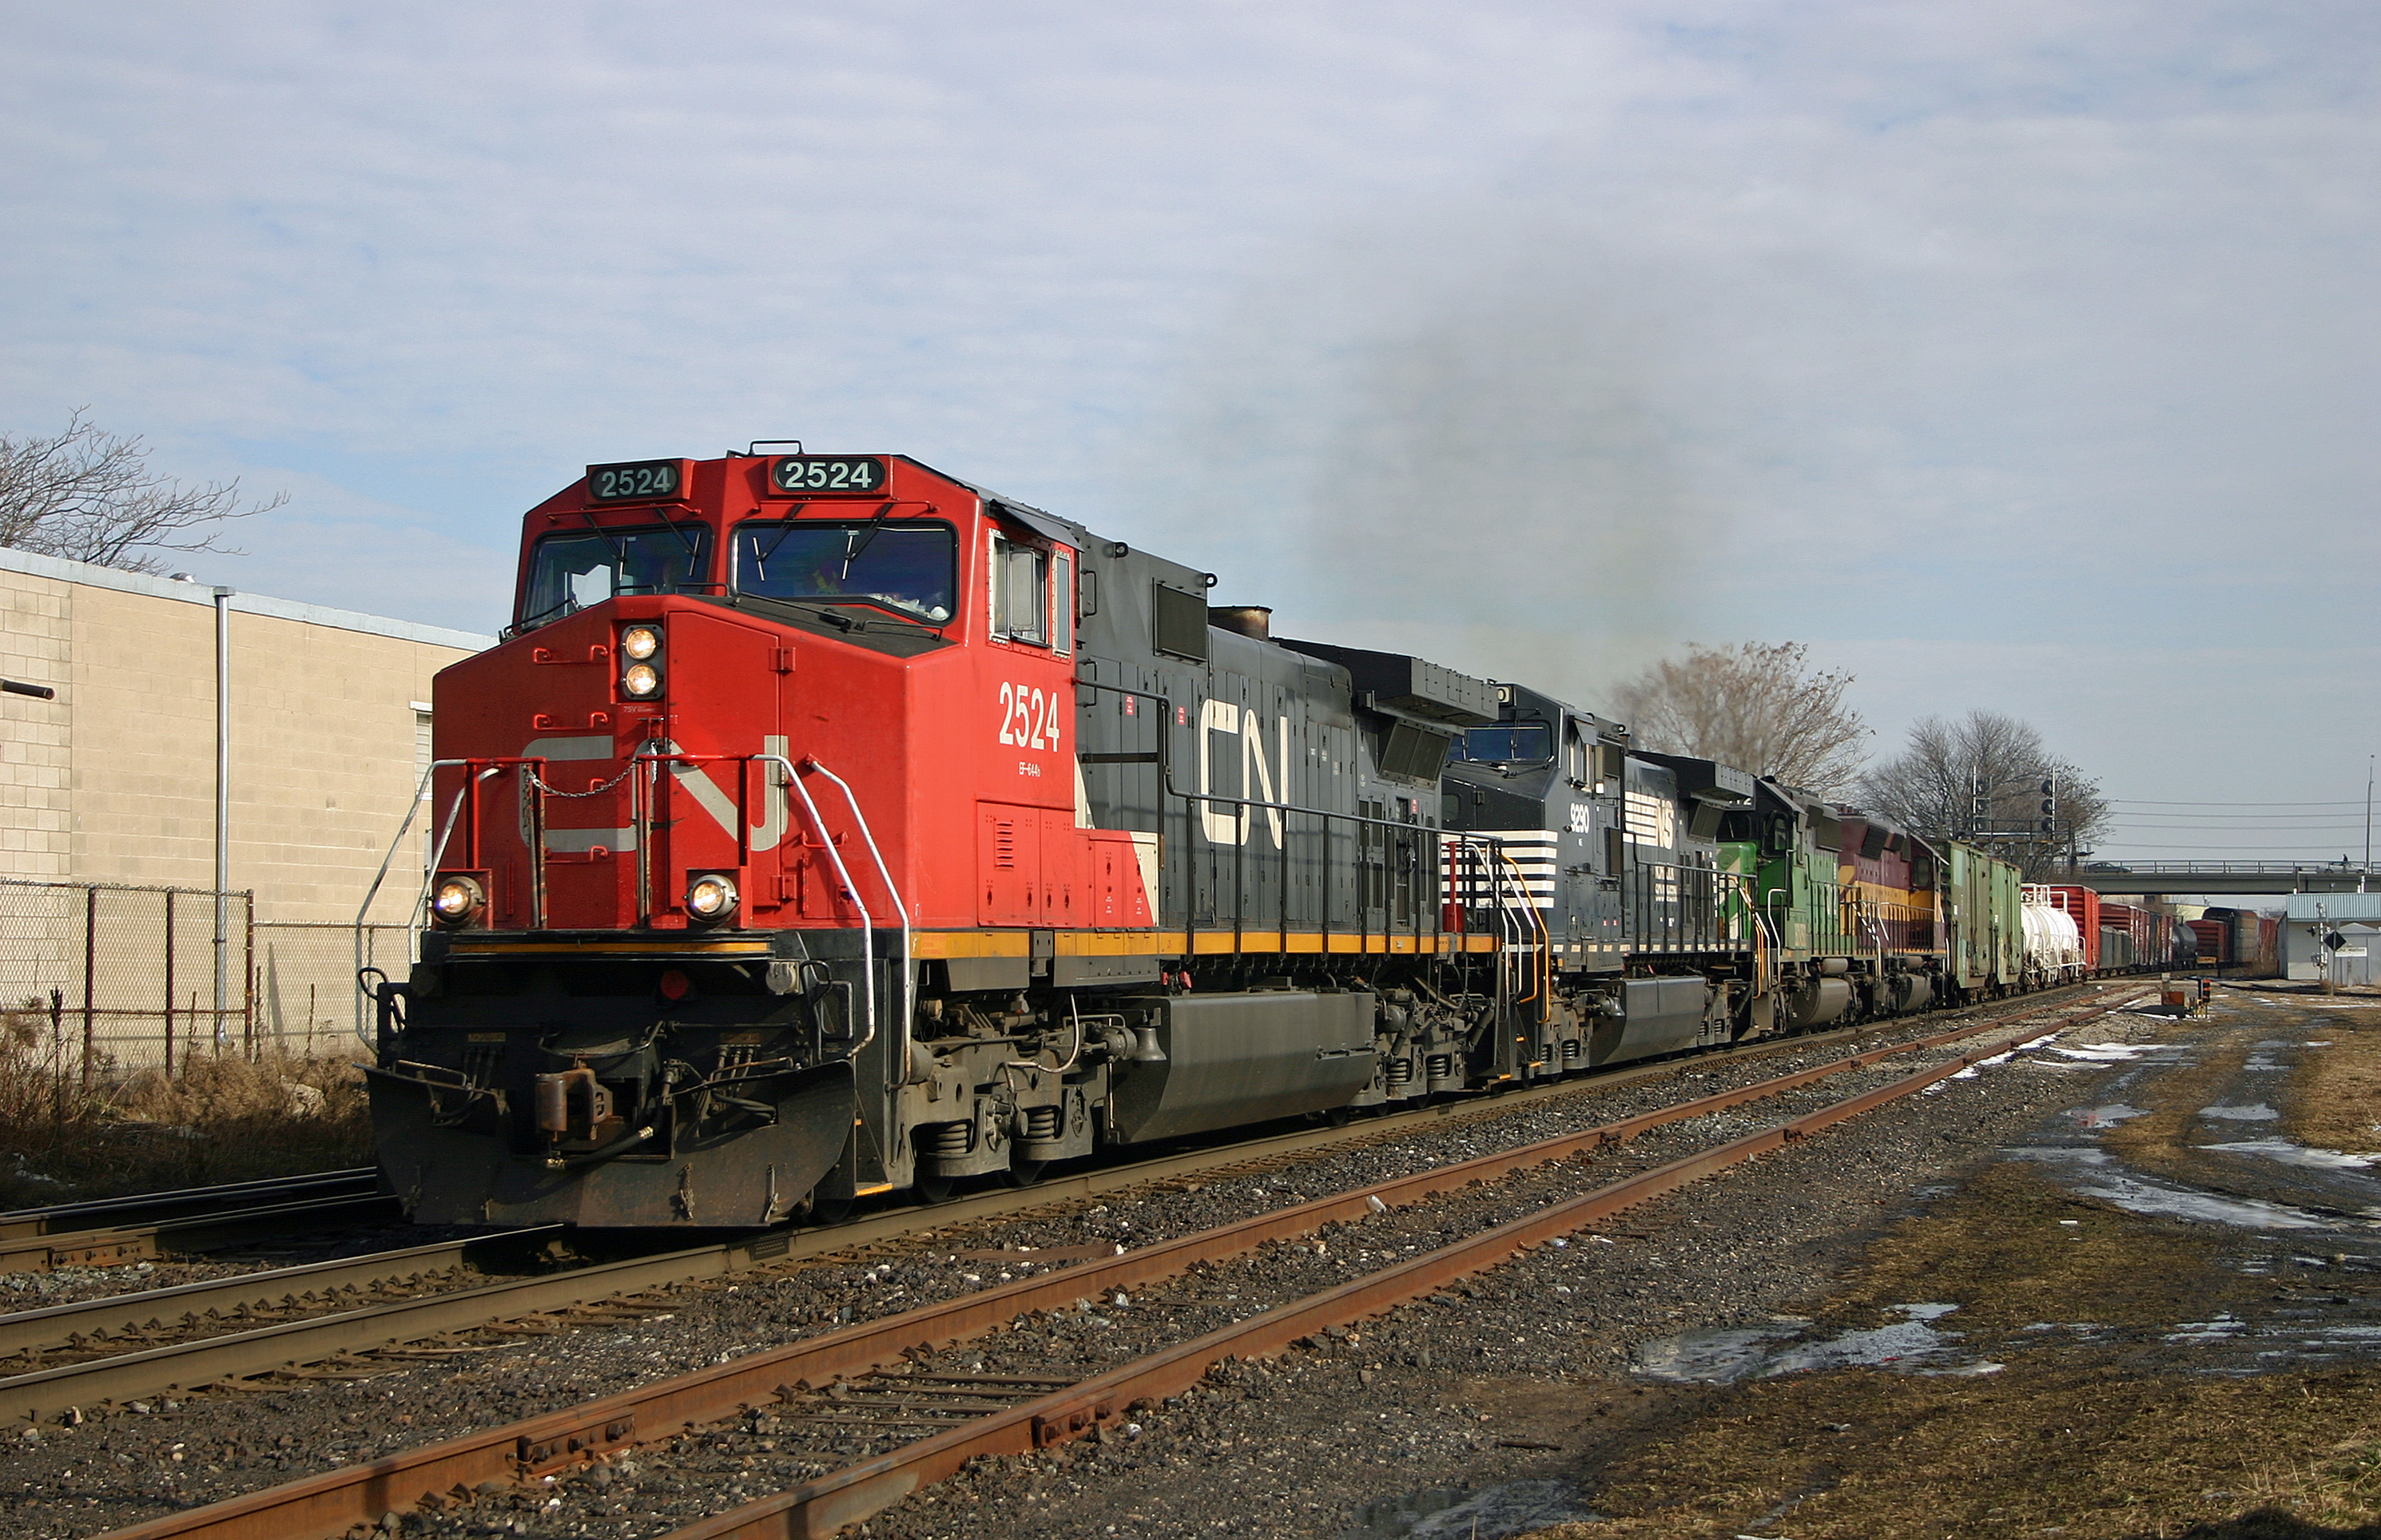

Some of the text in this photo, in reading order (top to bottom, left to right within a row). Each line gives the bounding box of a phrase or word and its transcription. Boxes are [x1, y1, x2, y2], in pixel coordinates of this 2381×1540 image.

[601, 466, 671, 498] 2524
[785, 462, 873, 489] 2524
[999, 681, 1060, 752] 2524
[519, 735, 789, 852] CN
[1200, 698, 1289, 851] CN
